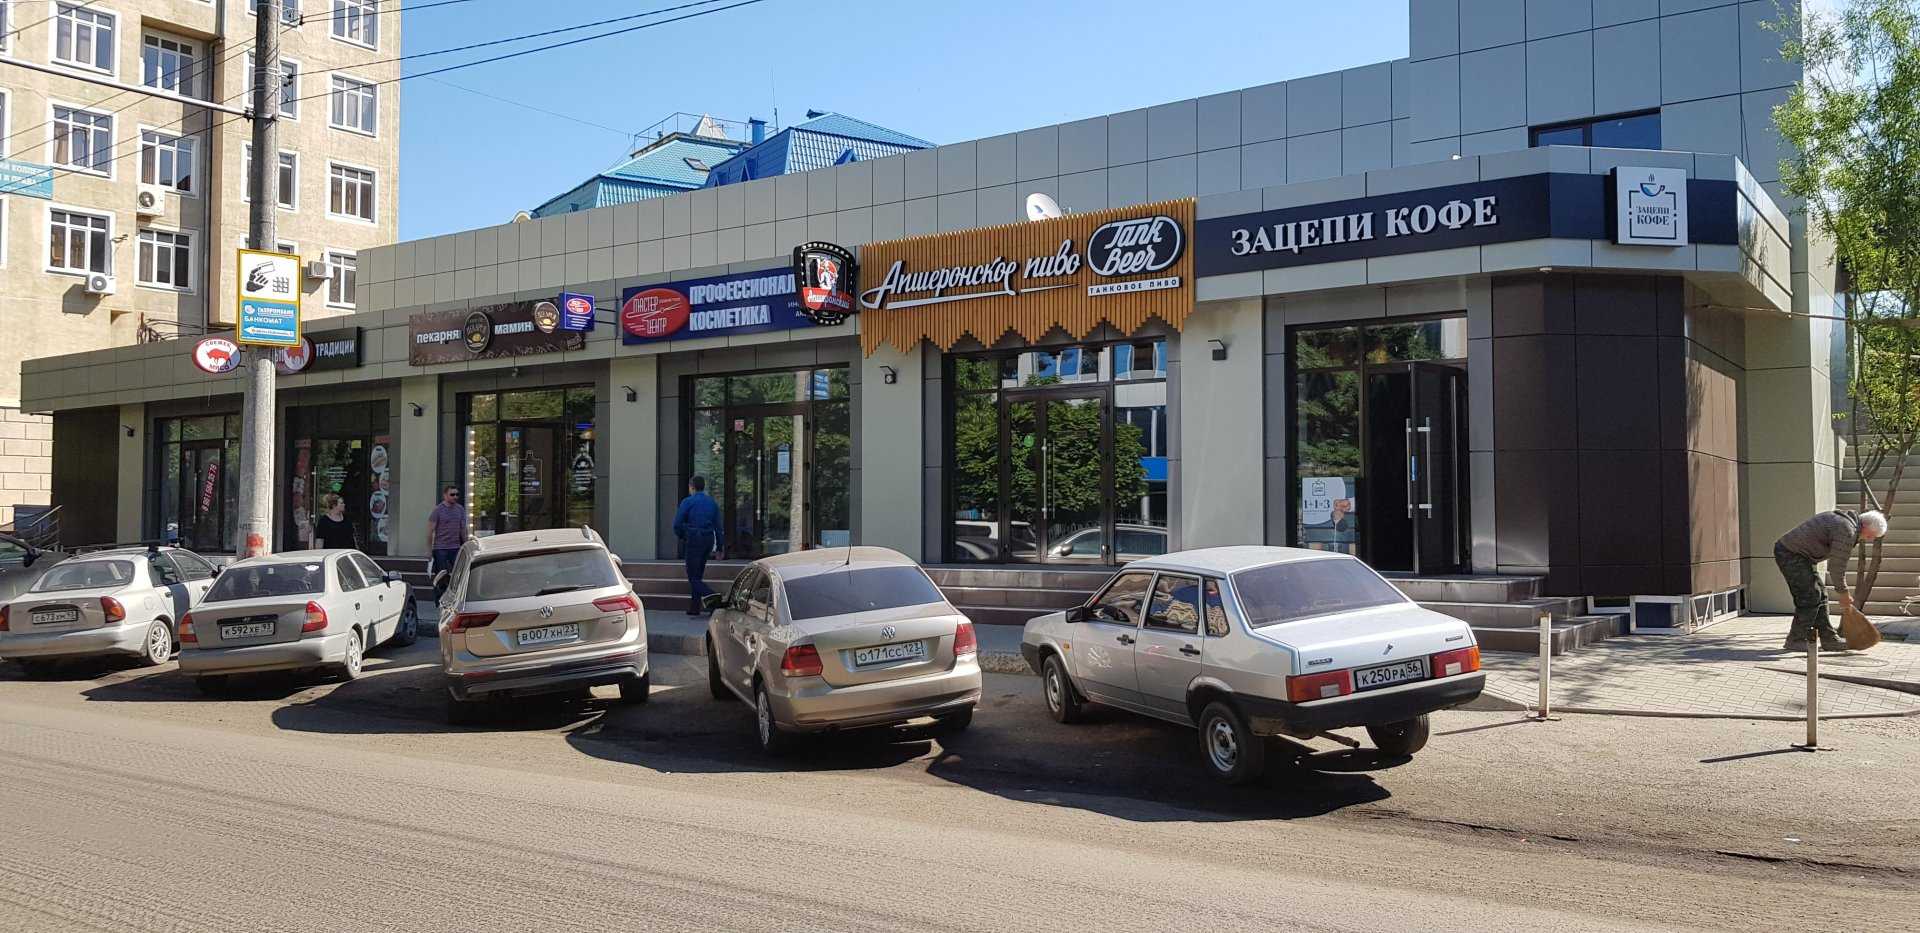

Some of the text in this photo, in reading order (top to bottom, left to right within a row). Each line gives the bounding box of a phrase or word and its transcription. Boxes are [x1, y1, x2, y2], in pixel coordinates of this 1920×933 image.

[1636, 205, 1670, 214] ЗАЦЕПИ
[1231, 195, 1497, 256] ЗАЦЕПИ КОФЕ
[1637, 215, 1670, 225] КОФЕ
[1104, 219, 1162, 249] Tank
[1104, 246, 1156, 275] Beer
[860, 239, 1080, 308] Апшеронское пиво
[689, 273, 797, 305] ПРОФЕССИОНАЛ
[1090, 279, 1177, 294] ТАНКОВОЕ ПИВО
[633, 296, 658, 313] МАСТЕР
[244, 315, 282, 324] БАНКОМАТ
[643, 317, 667, 334] ЦЕНТР
[689, 305, 771, 331] КОСМЕТИКА
[416, 329, 460, 345] пекарня
[315, 339, 355, 357] ТРАДИЦИИ
